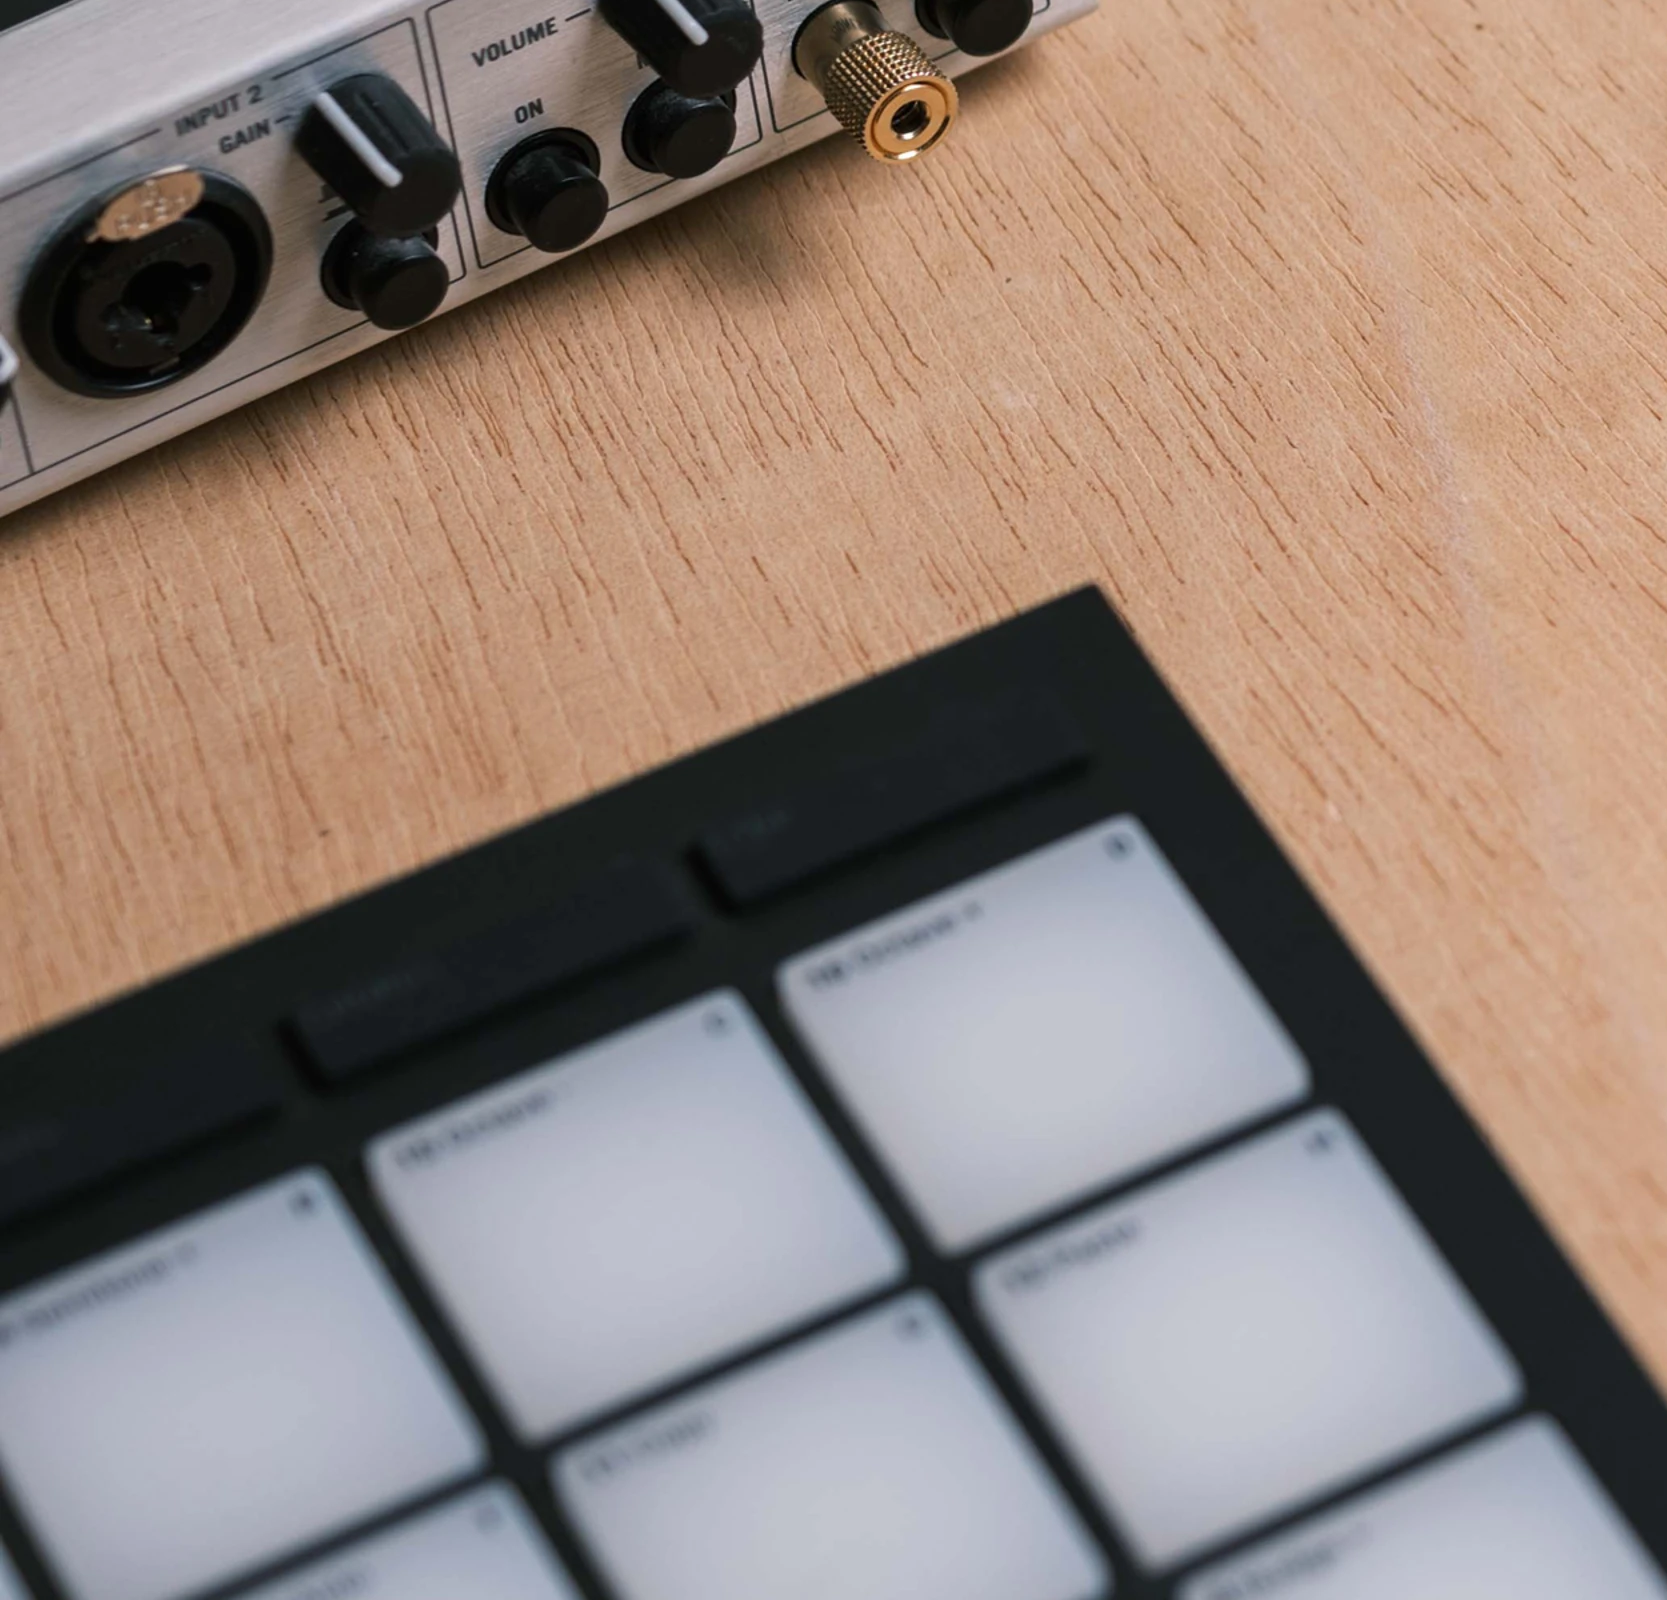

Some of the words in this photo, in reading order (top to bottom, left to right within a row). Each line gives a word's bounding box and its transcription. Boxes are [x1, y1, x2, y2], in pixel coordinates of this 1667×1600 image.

[471, 16, 559, 68] VOLUME
[174, 91, 241, 138] INPUT
[246, 84, 263, 105] 2
[514, 97, 544, 125] ON
[217, 117, 271, 154] GAIN
